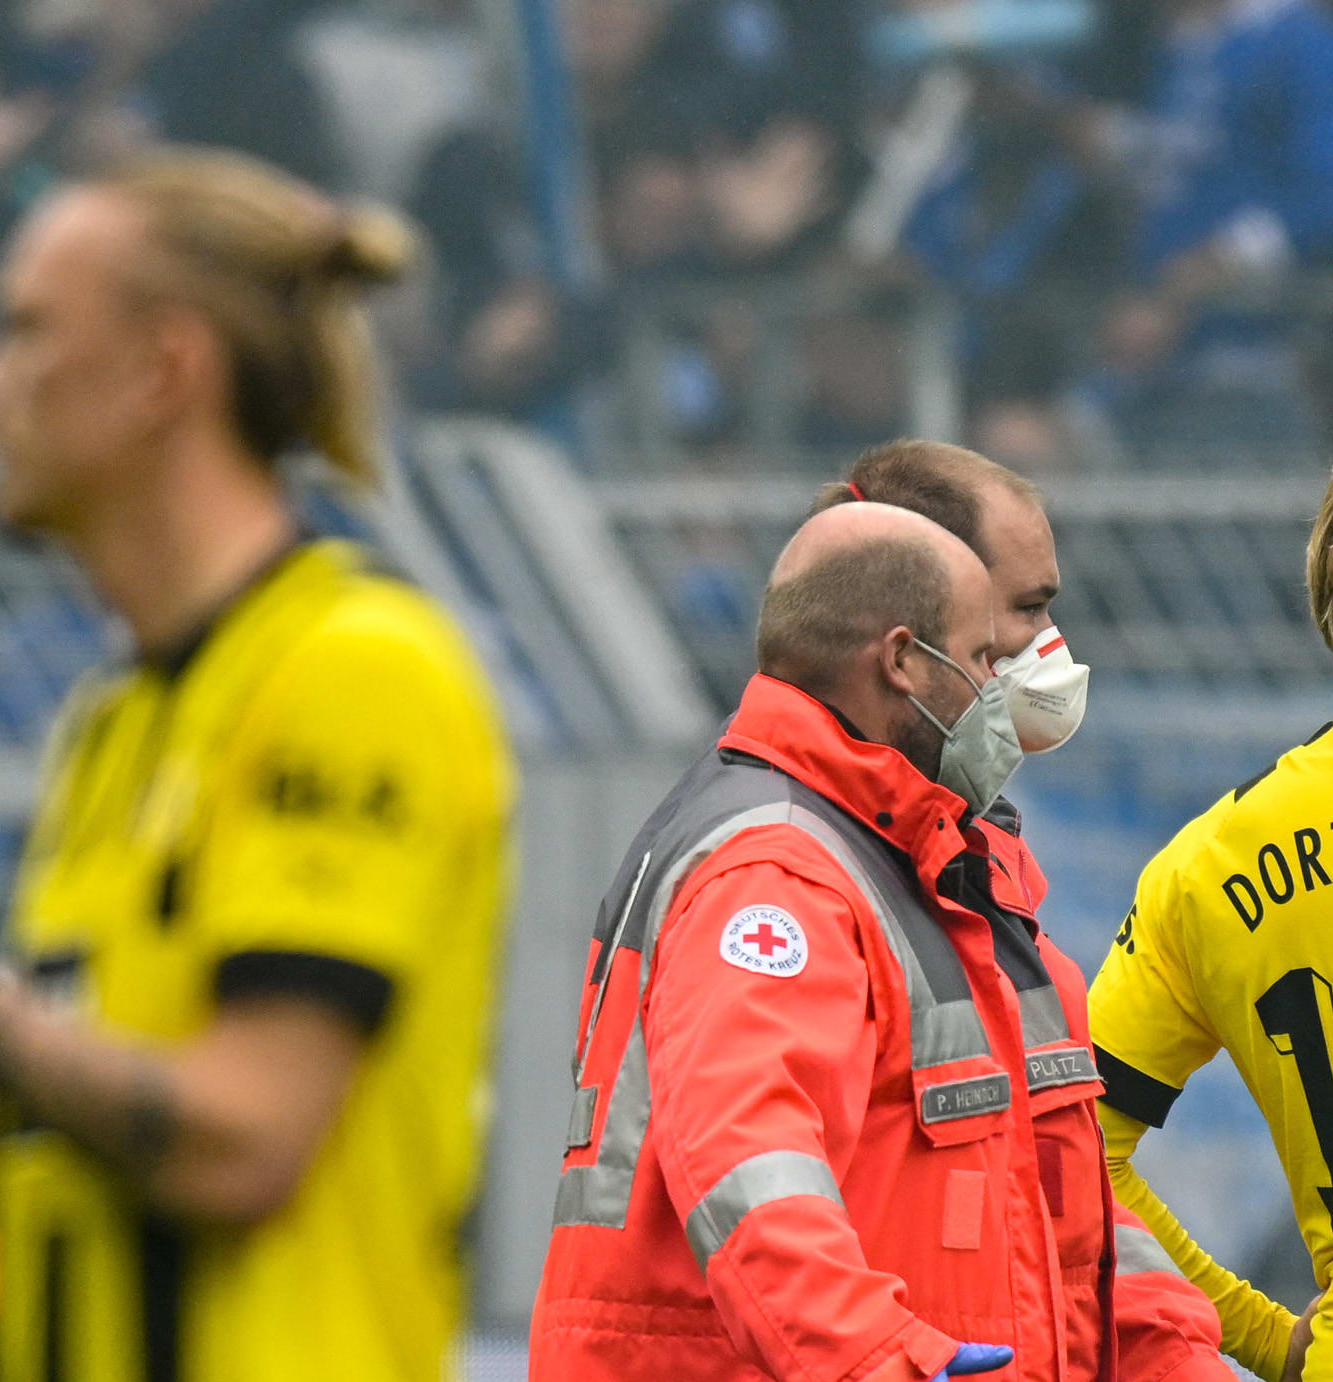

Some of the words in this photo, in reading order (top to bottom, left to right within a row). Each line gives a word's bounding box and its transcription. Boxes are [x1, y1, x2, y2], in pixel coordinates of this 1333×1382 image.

[1222, 822, 1333, 933] DOR
[1030, 1056, 1081, 1079] PLATZ
[937, 1094, 952, 1112] P.
